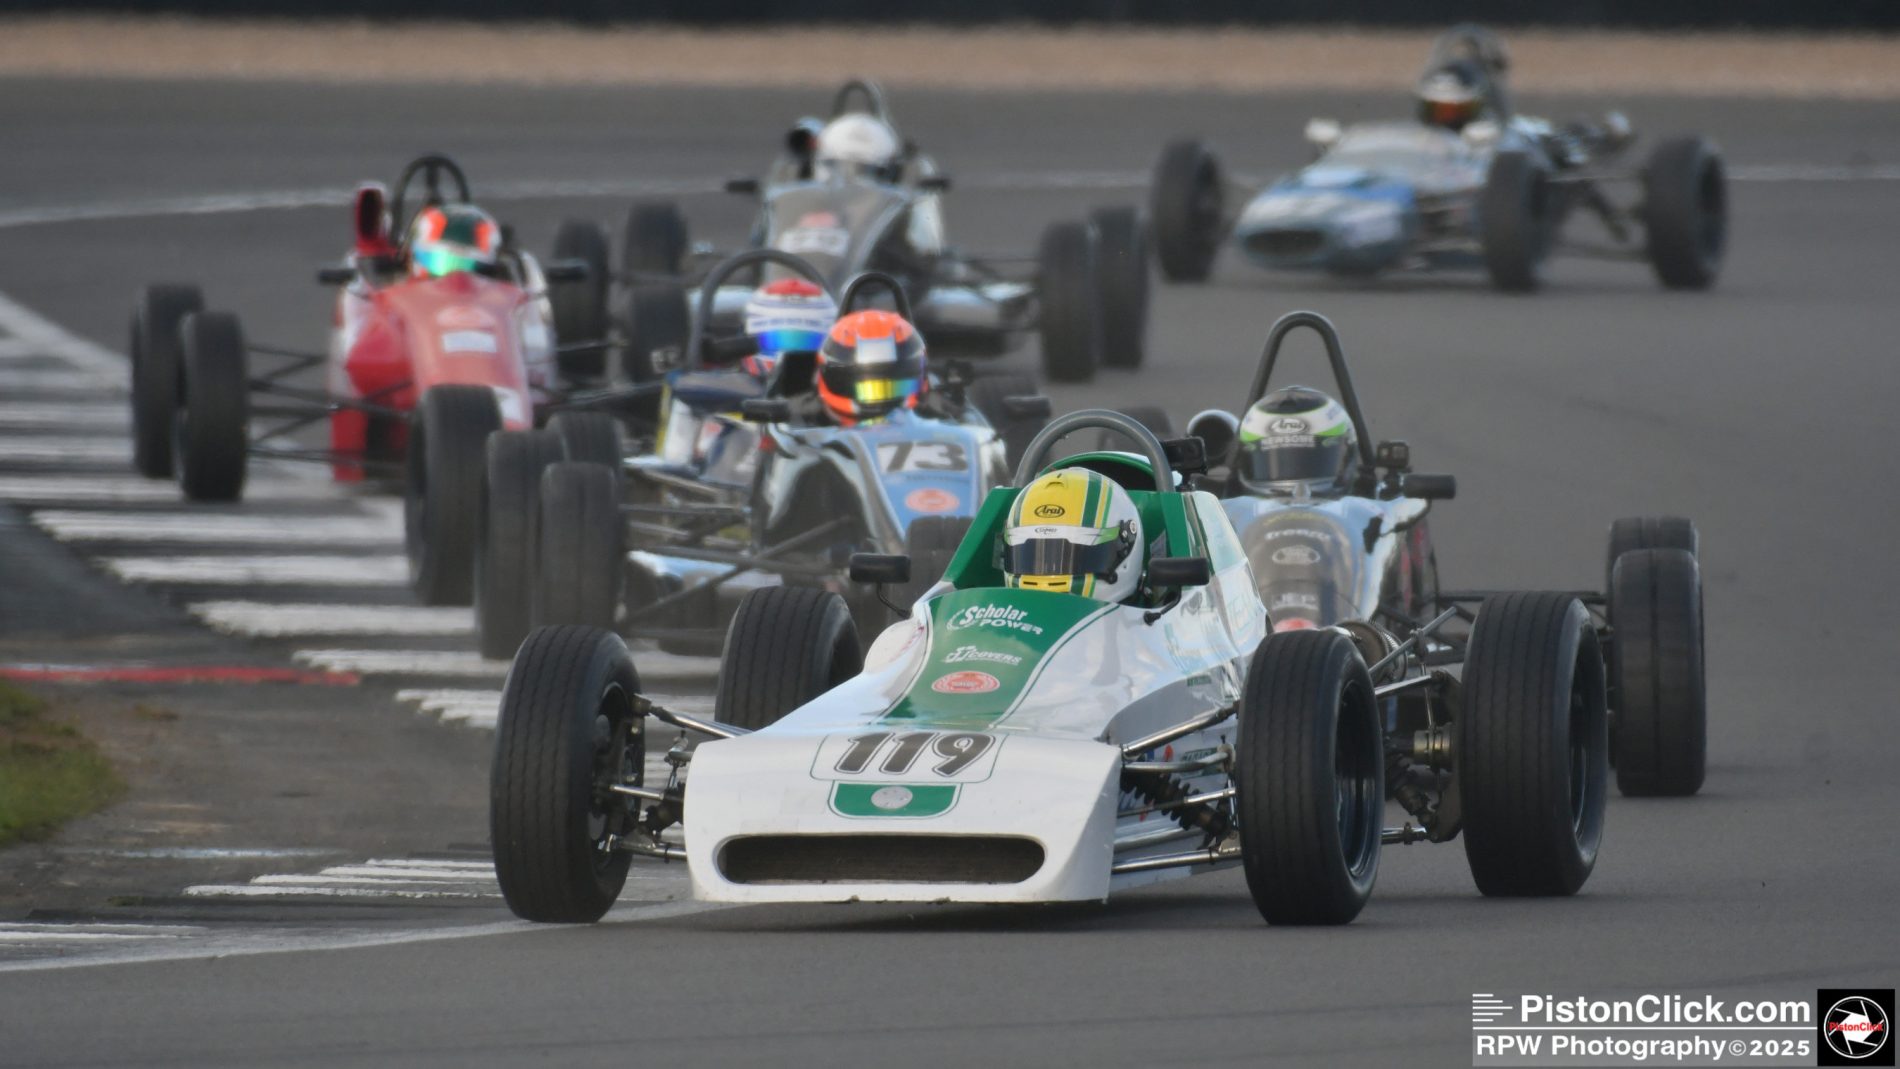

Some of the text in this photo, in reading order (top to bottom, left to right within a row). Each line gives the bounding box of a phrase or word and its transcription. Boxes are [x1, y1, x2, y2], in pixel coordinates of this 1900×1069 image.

[877, 440, 968, 472] 73
[959, 603, 1028, 626] Scholar
[978, 618, 1043, 635] POWER
[834, 731, 996, 778] 119
